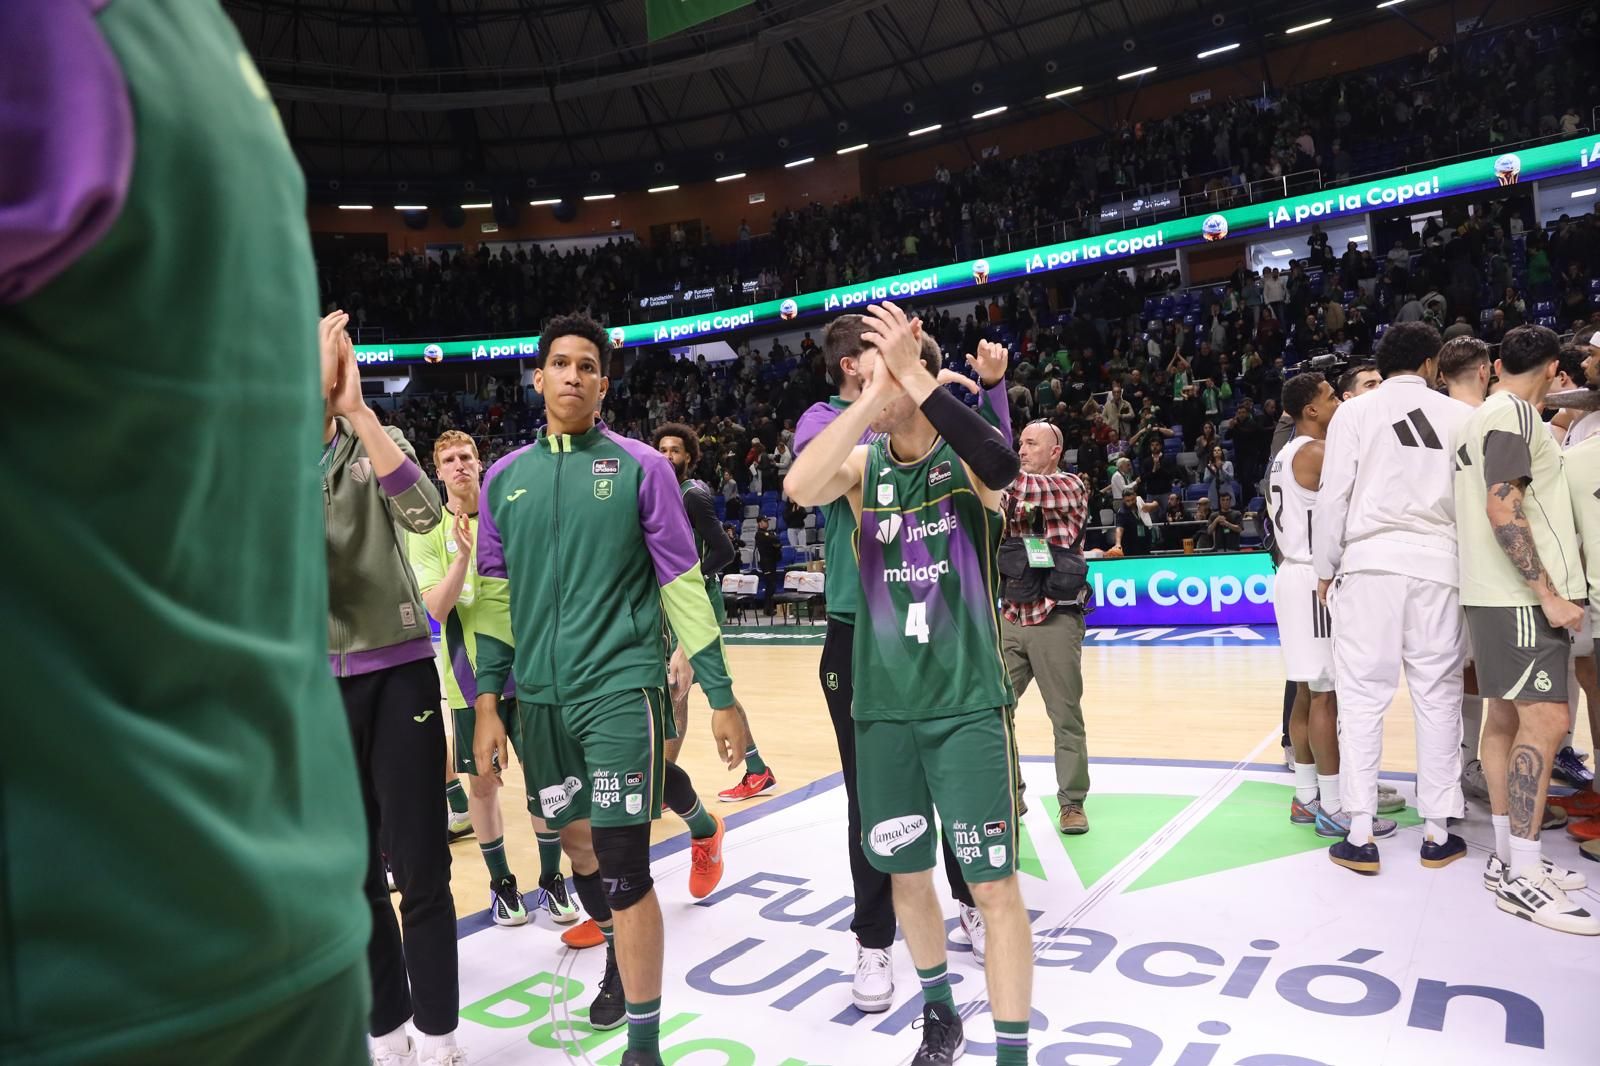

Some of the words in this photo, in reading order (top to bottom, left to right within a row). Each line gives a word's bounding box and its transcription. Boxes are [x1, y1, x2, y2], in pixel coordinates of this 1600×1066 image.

[1268, 207, 1291, 228] ¡A
[1295, 198, 1332, 223] por
[1339, 193, 1361, 210] la
[1366, 176, 1439, 206] Copa!
[1025, 254, 1044, 272] ¡A
[1048, 246, 1079, 268] por
[1082, 241, 1101, 258] la
[1105, 230, 1163, 255] Copa!
[824, 294, 840, 311] ¡A
[842, 291, 869, 308] por
[871, 284, 888, 299] la
[890, 274, 938, 296] Copa!
[654, 327, 668, 343] ¡A
[670, 324, 696, 339] por
[698, 318, 711, 330] la
[713, 310, 754, 331] Copa!
[354, 349, 394, 364] opa!
[472, 346, 488, 360] ¡A
[490, 346, 516, 360] por
[519, 344, 534, 356] la
[1094, 573, 1136, 607] la
[904, 601, 930, 643] 4
